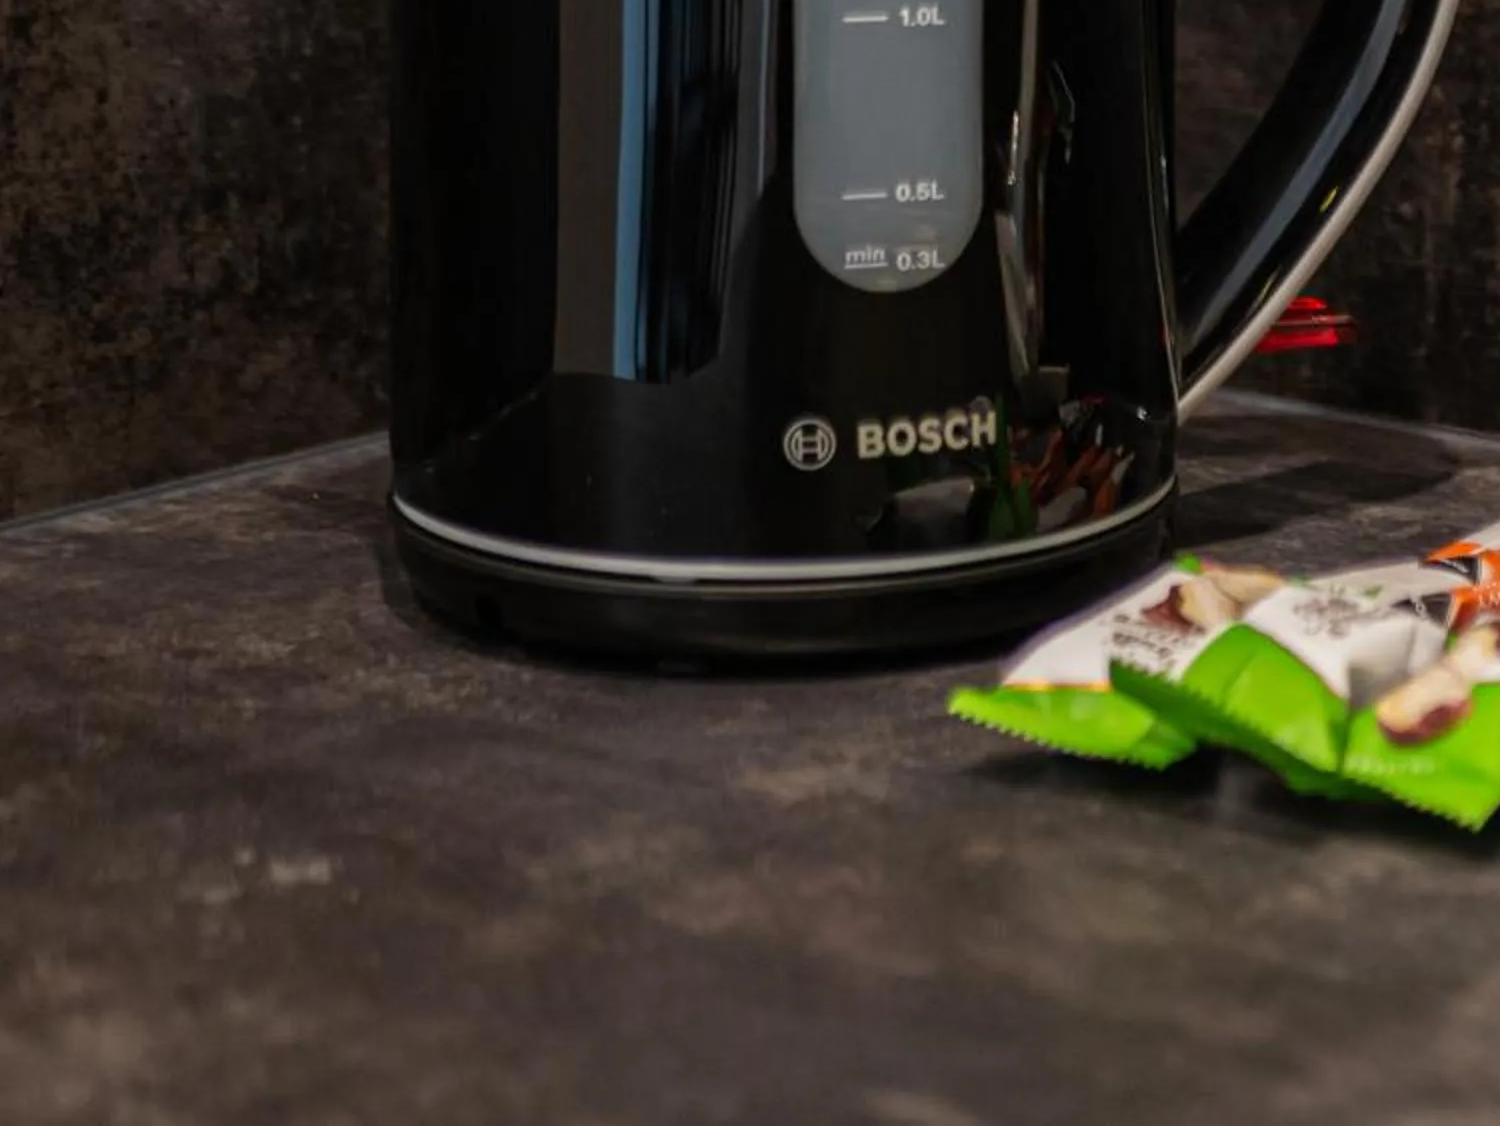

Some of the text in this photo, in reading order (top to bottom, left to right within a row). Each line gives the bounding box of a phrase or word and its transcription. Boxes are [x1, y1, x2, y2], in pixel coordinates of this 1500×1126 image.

[900, 5, 946, 27] 1.0L
[895, 180, 945, 203] 0.5L
[845, 244, 946, 272] min 0.3L
[857, 411, 997, 459] BOSCH
